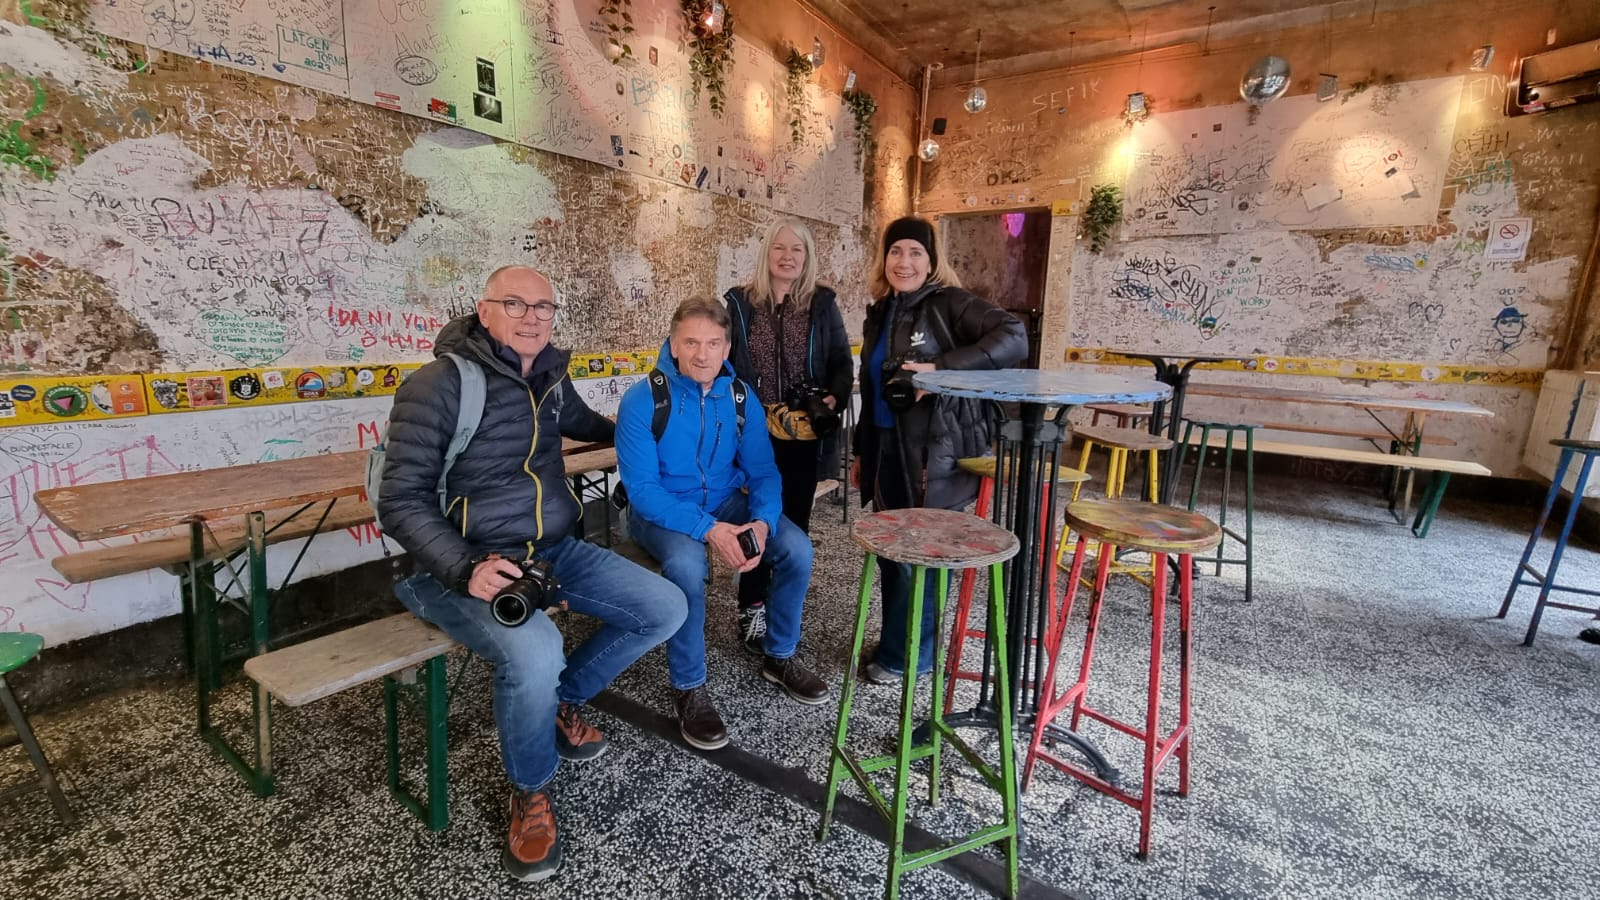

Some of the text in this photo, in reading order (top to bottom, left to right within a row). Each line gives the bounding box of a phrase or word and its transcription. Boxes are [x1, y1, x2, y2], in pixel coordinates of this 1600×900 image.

[1208, 155, 1276, 188] FUCK
[186, 255, 248, 271] CZECH
[30, 424, 60, 433] VISCA
[64, 423, 73, 431] LA
